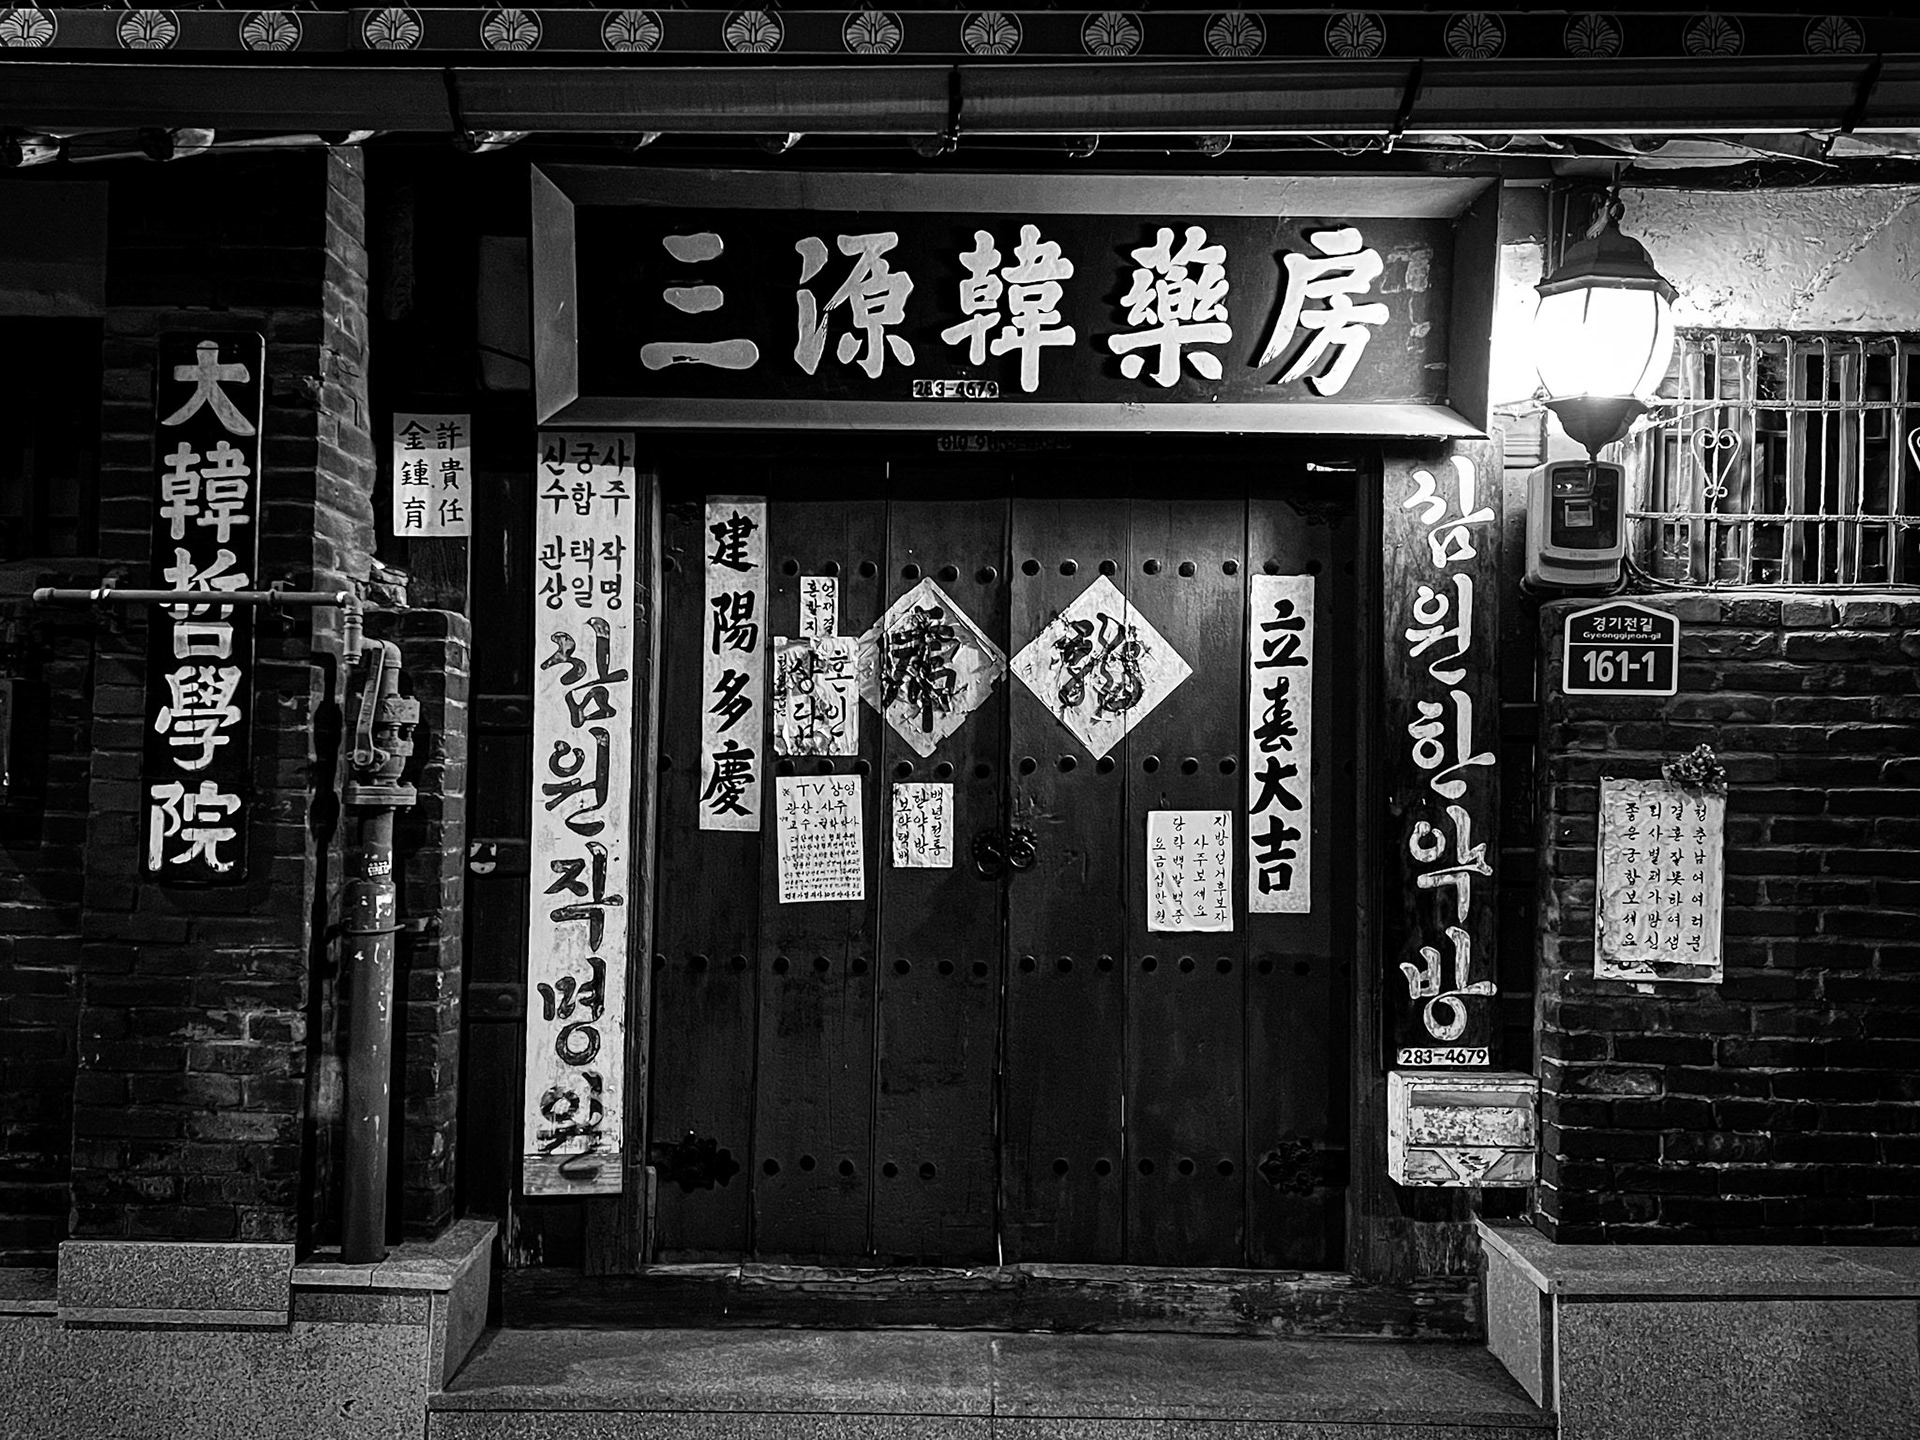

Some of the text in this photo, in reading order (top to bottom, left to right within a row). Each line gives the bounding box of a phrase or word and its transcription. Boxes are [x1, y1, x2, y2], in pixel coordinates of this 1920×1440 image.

[640, 224, 1389, 395] 三源韓藥房
[914, 381, 998, 396] 283-4679
[149, 340, 255, 872] 大韓哲學院
[538, 437, 569, 610] 신수 관상
[570, 443, 600, 608] 궁합 택일
[598, 438, 631, 610] 사주 작명
[700, 510, 758, 816] 建陽多慶
[825, 650, 854, 738] 혼인
[1583, 631, 1661, 640] Gyeonggijeon-gil
[1583, 650, 1655, 682] 161-1
[1592, 617, 1653, 632] 경기전길
[796, 784, 825, 797] TV
[1249, 599, 1308, 894] 立春大吉
[1400, 456, 1497, 1040] 삼원한약방
[537, 616, 629, 1180] 삼원작명원
[1402, 1049, 1487, 1064] 283-4679
